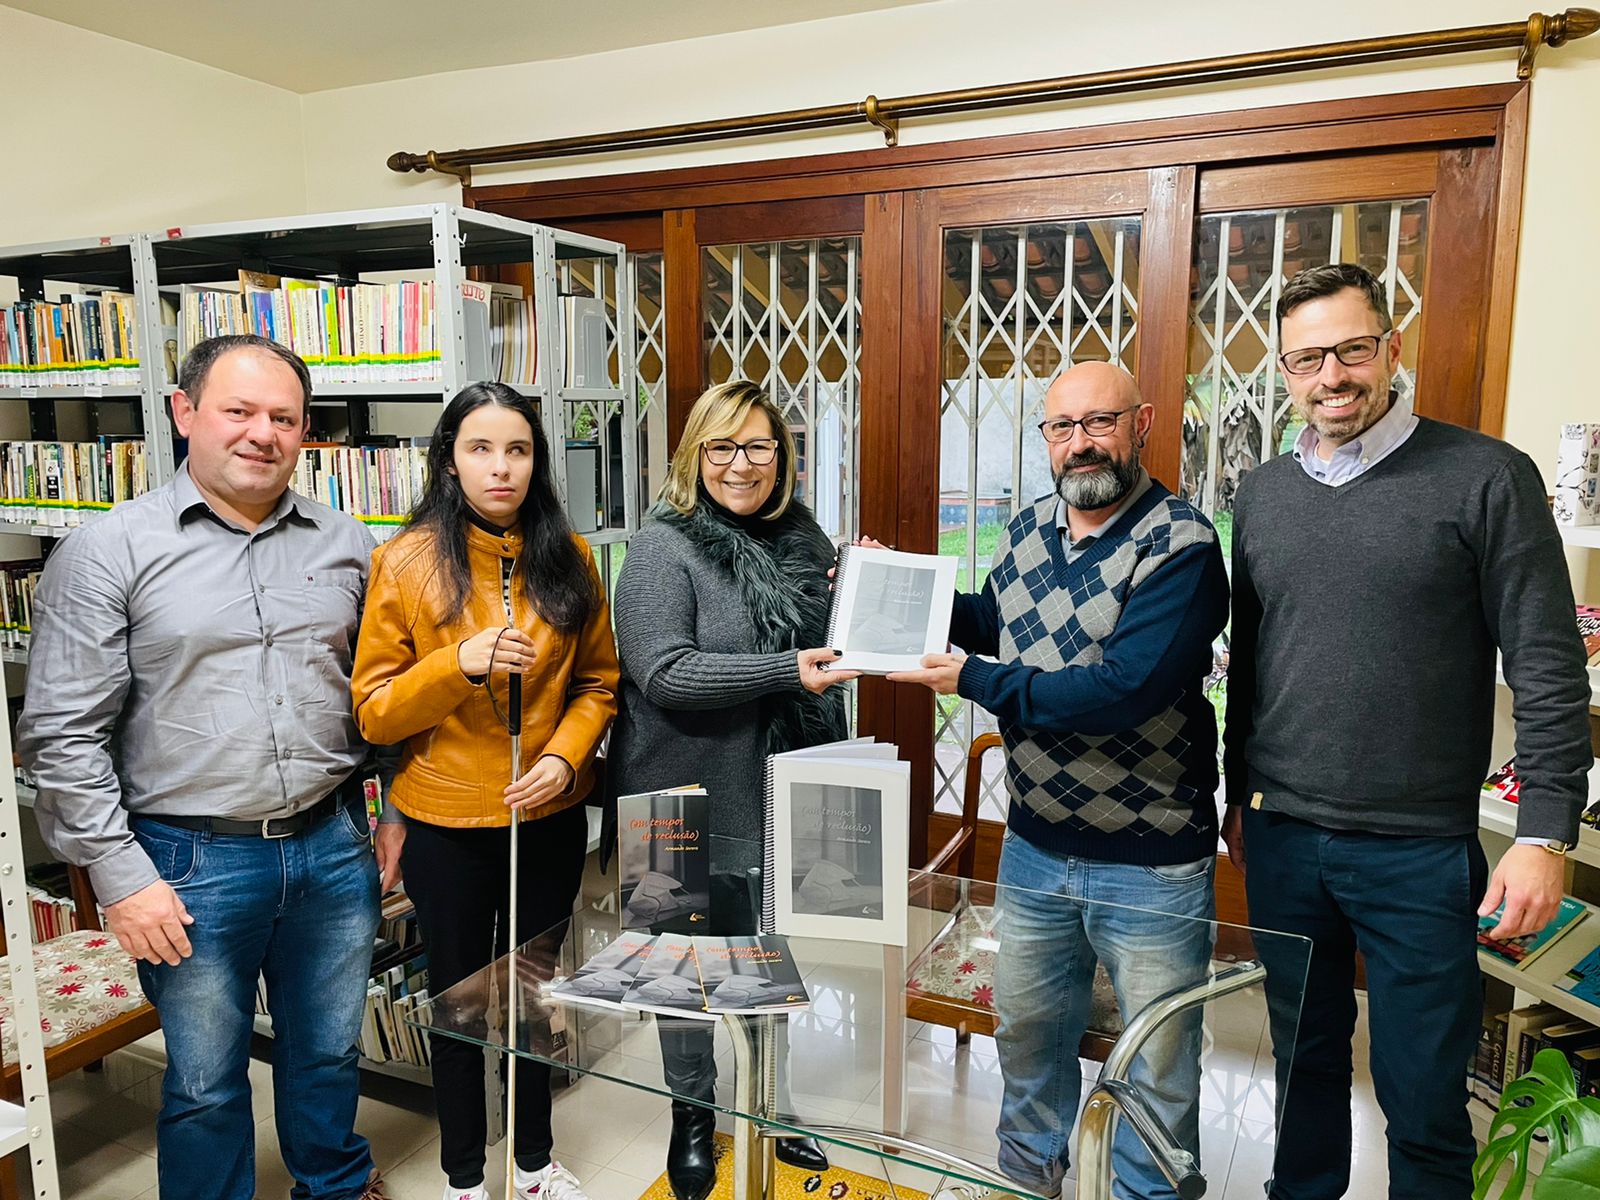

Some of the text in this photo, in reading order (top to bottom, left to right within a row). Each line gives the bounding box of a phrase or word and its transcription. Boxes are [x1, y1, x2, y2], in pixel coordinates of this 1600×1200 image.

[650, 817, 685, 830] tempos
[640, 829, 699, 841] de reclusão)
